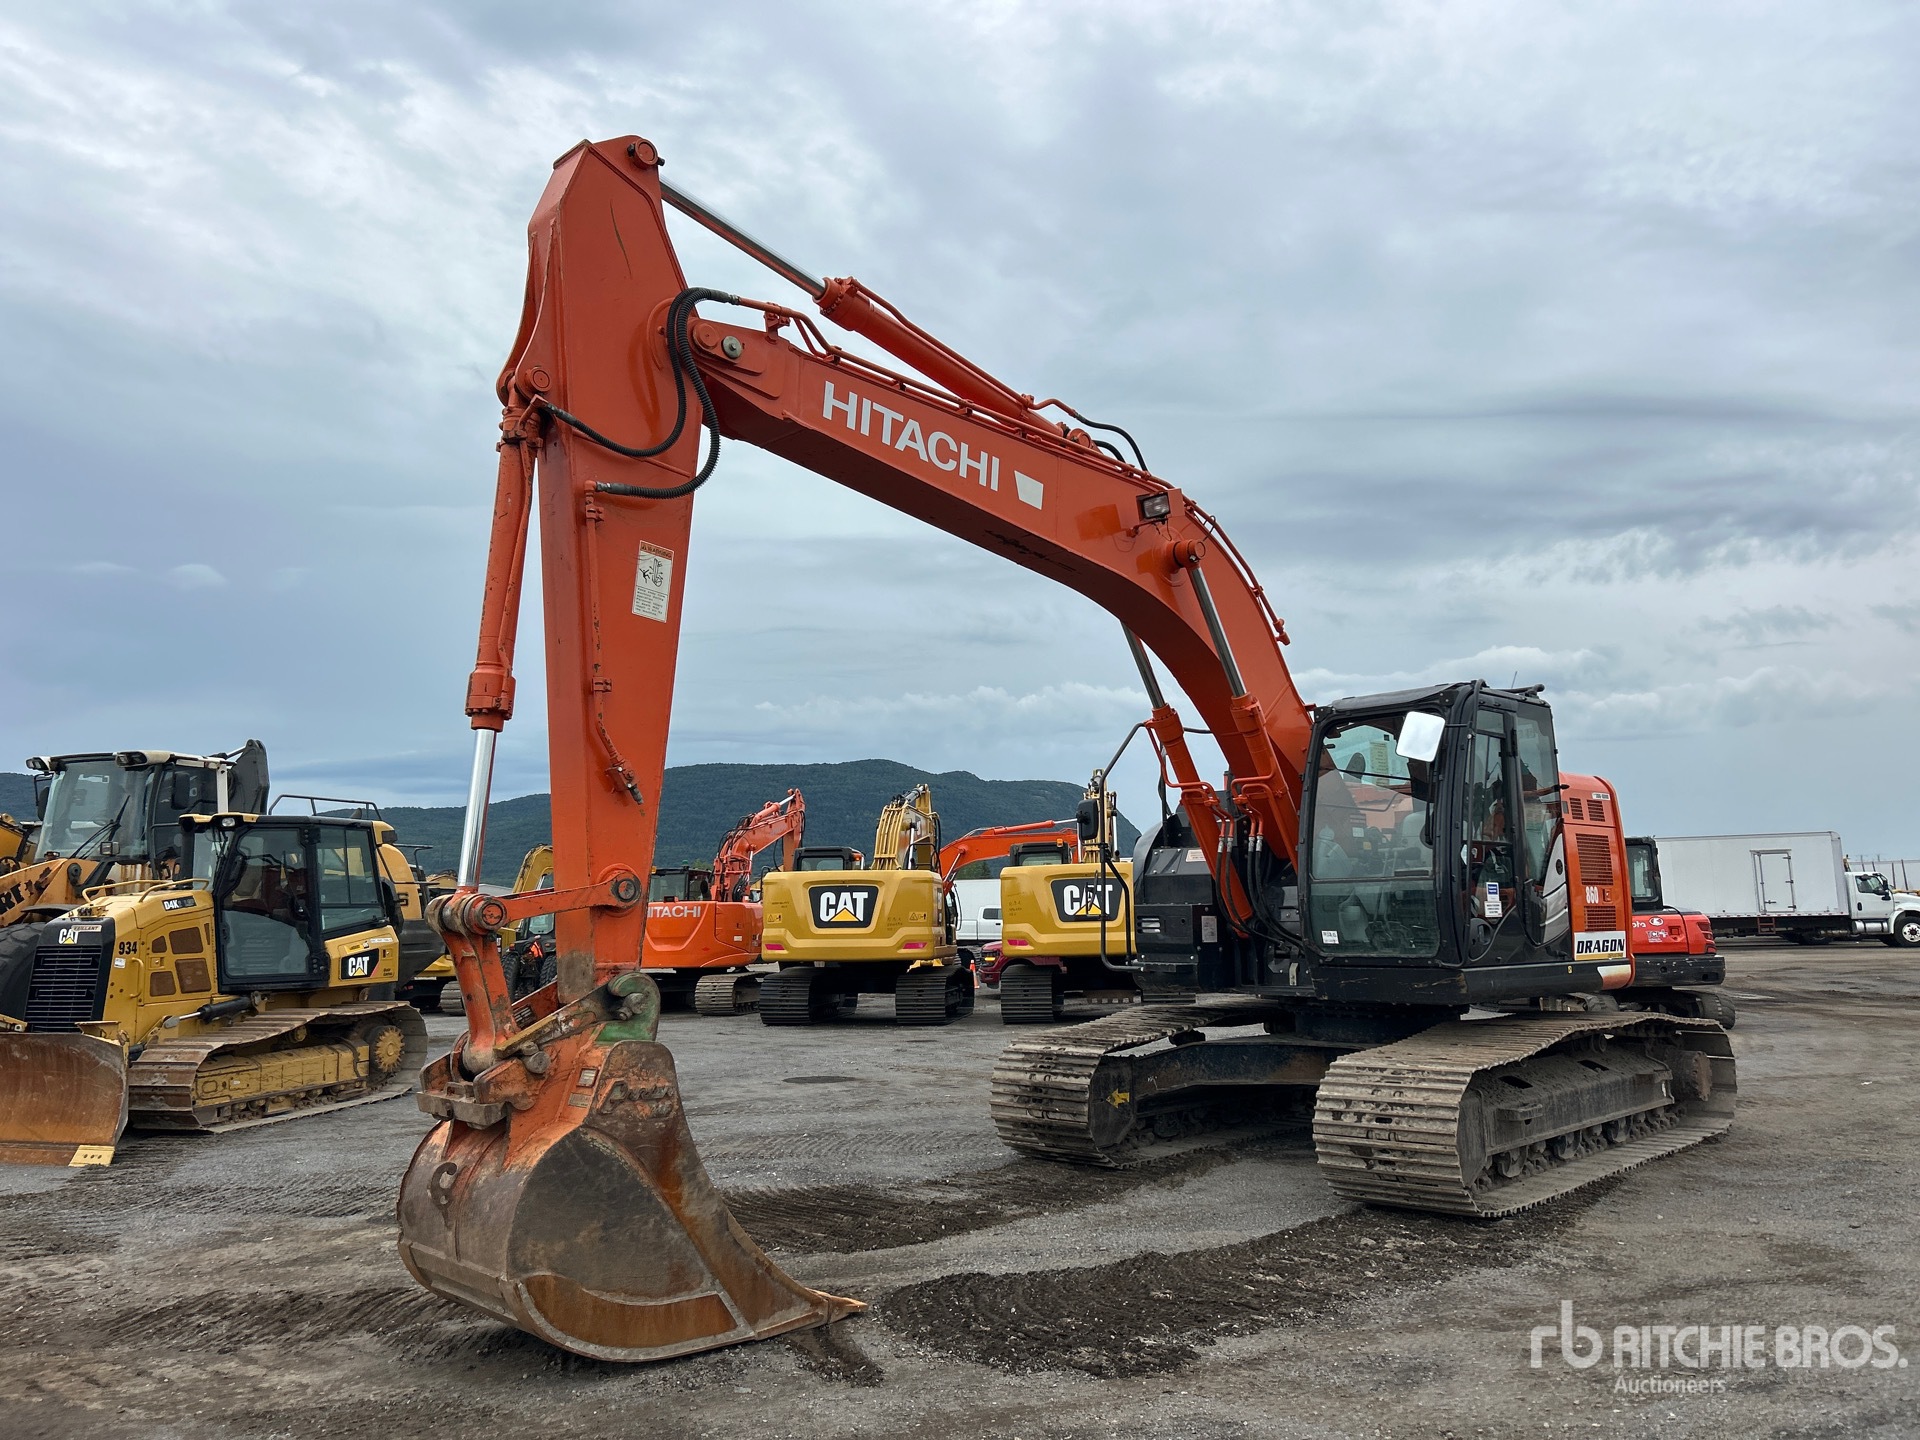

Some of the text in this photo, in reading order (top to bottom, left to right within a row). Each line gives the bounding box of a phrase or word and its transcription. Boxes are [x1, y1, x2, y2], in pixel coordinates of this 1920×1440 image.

[823, 381, 1000, 492] HITACHI
[1063, 884, 1113, 916] CAT
[1585, 886, 1599, 904] 860
[820, 892, 869, 922] CAT
[1632, 920, 1646, 928] ota
[58, 928, 79, 945] CAT
[118, 941, 138, 955] 934
[1576, 938, 1625, 954] DRAGON
[348, 956, 370, 977] CAT
